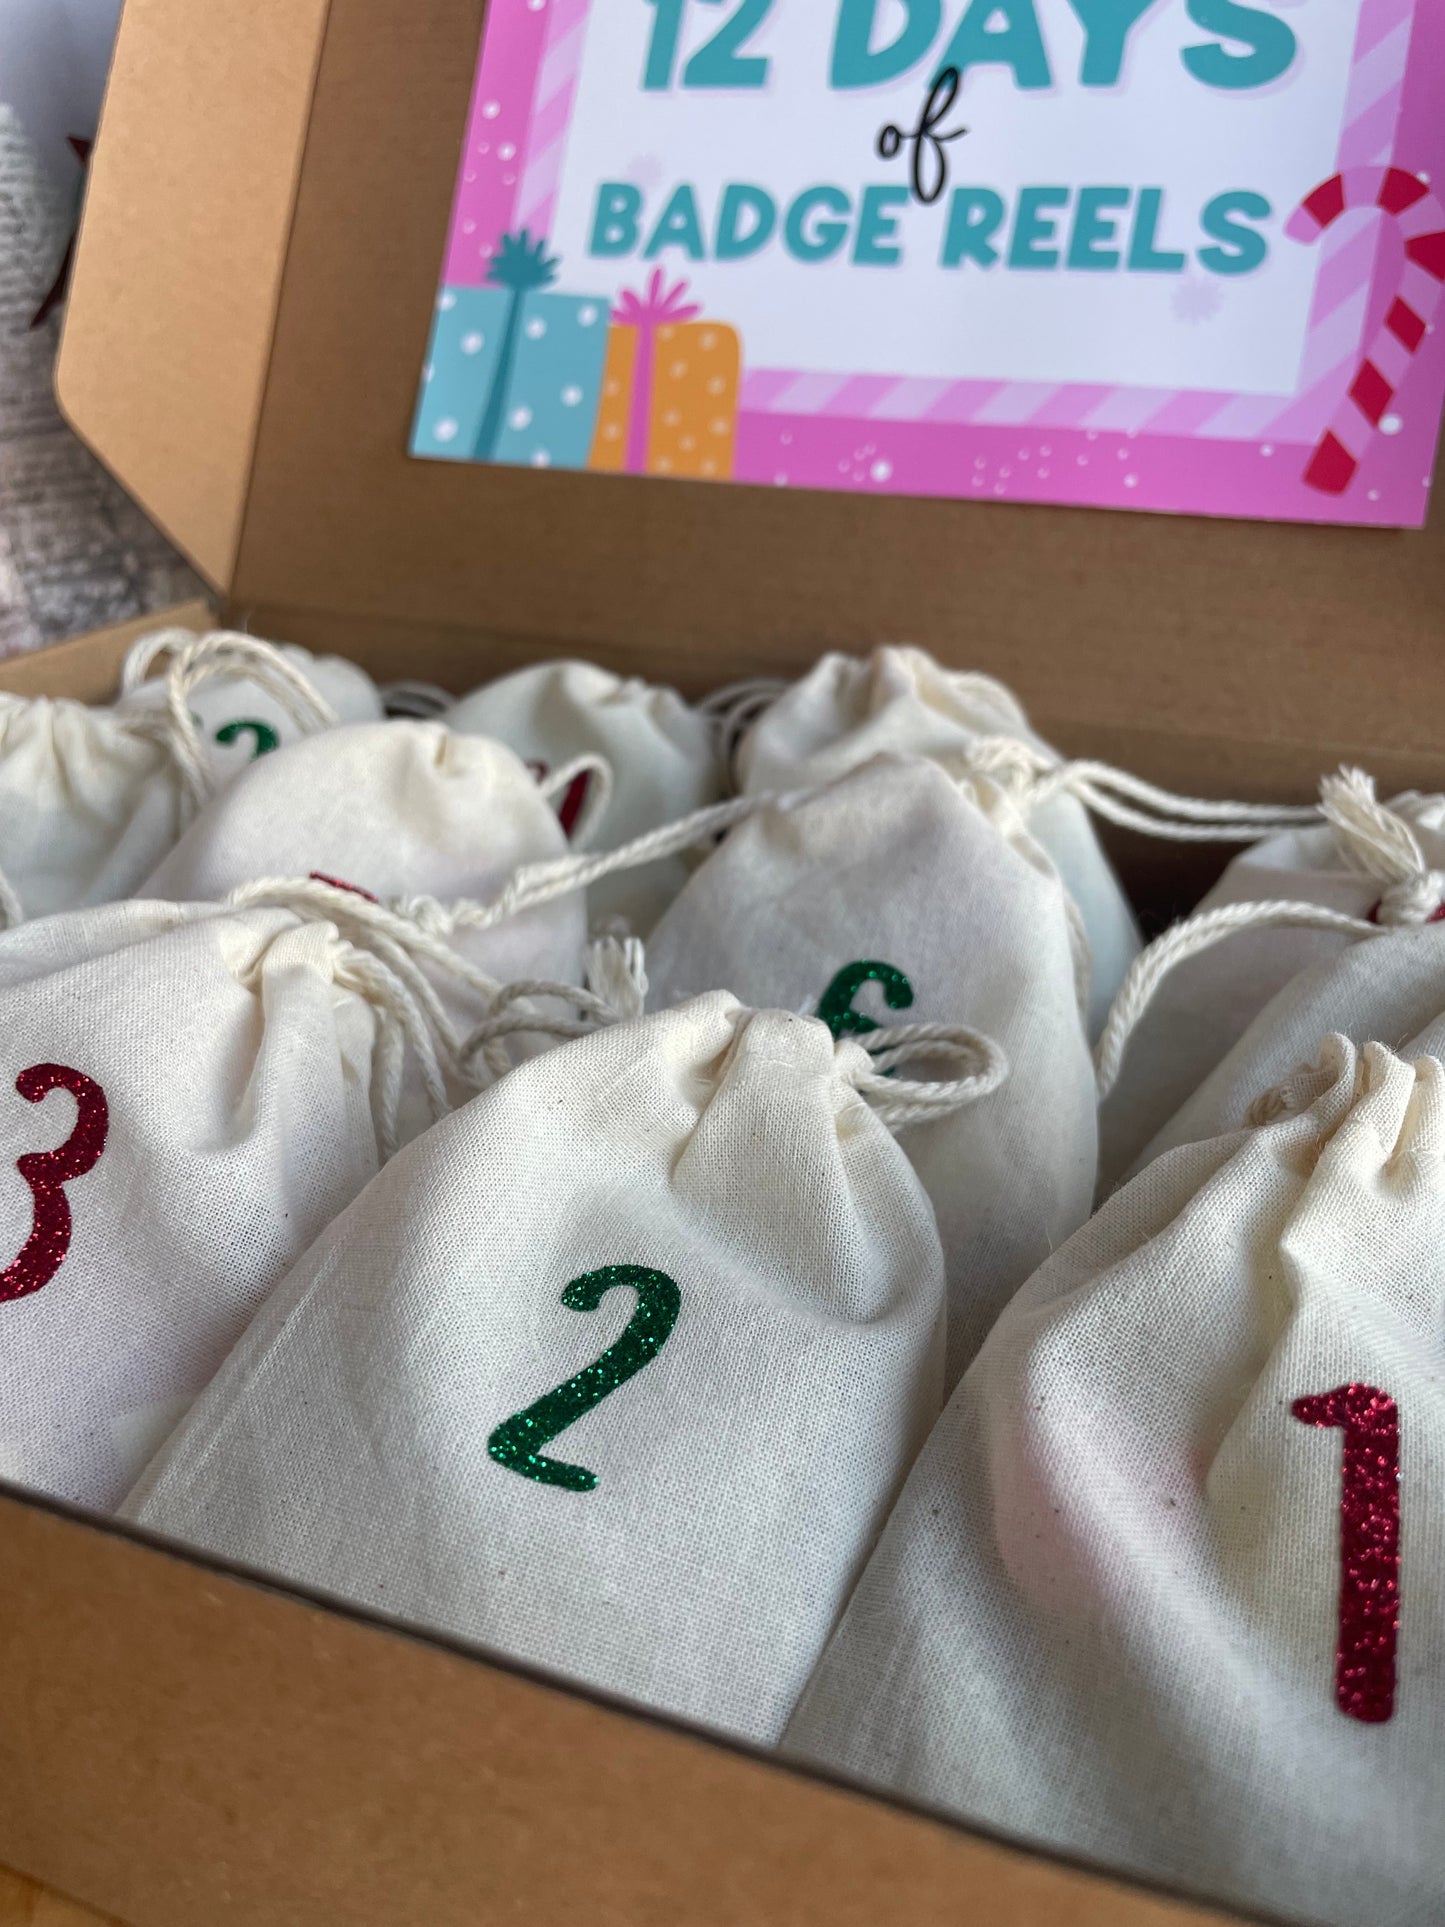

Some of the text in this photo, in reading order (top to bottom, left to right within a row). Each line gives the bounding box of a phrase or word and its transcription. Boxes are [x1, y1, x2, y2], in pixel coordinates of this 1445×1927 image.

[640, 0, 1297, 91] 12 DAYS
[876, 65, 968, 205] of
[588, 181, 1272, 276] BADGE REELS
[0, 1062, 109, 1300] 3
[487, 1263, 682, 1493] 2
[1290, 1381, 1400, 1724] 1
